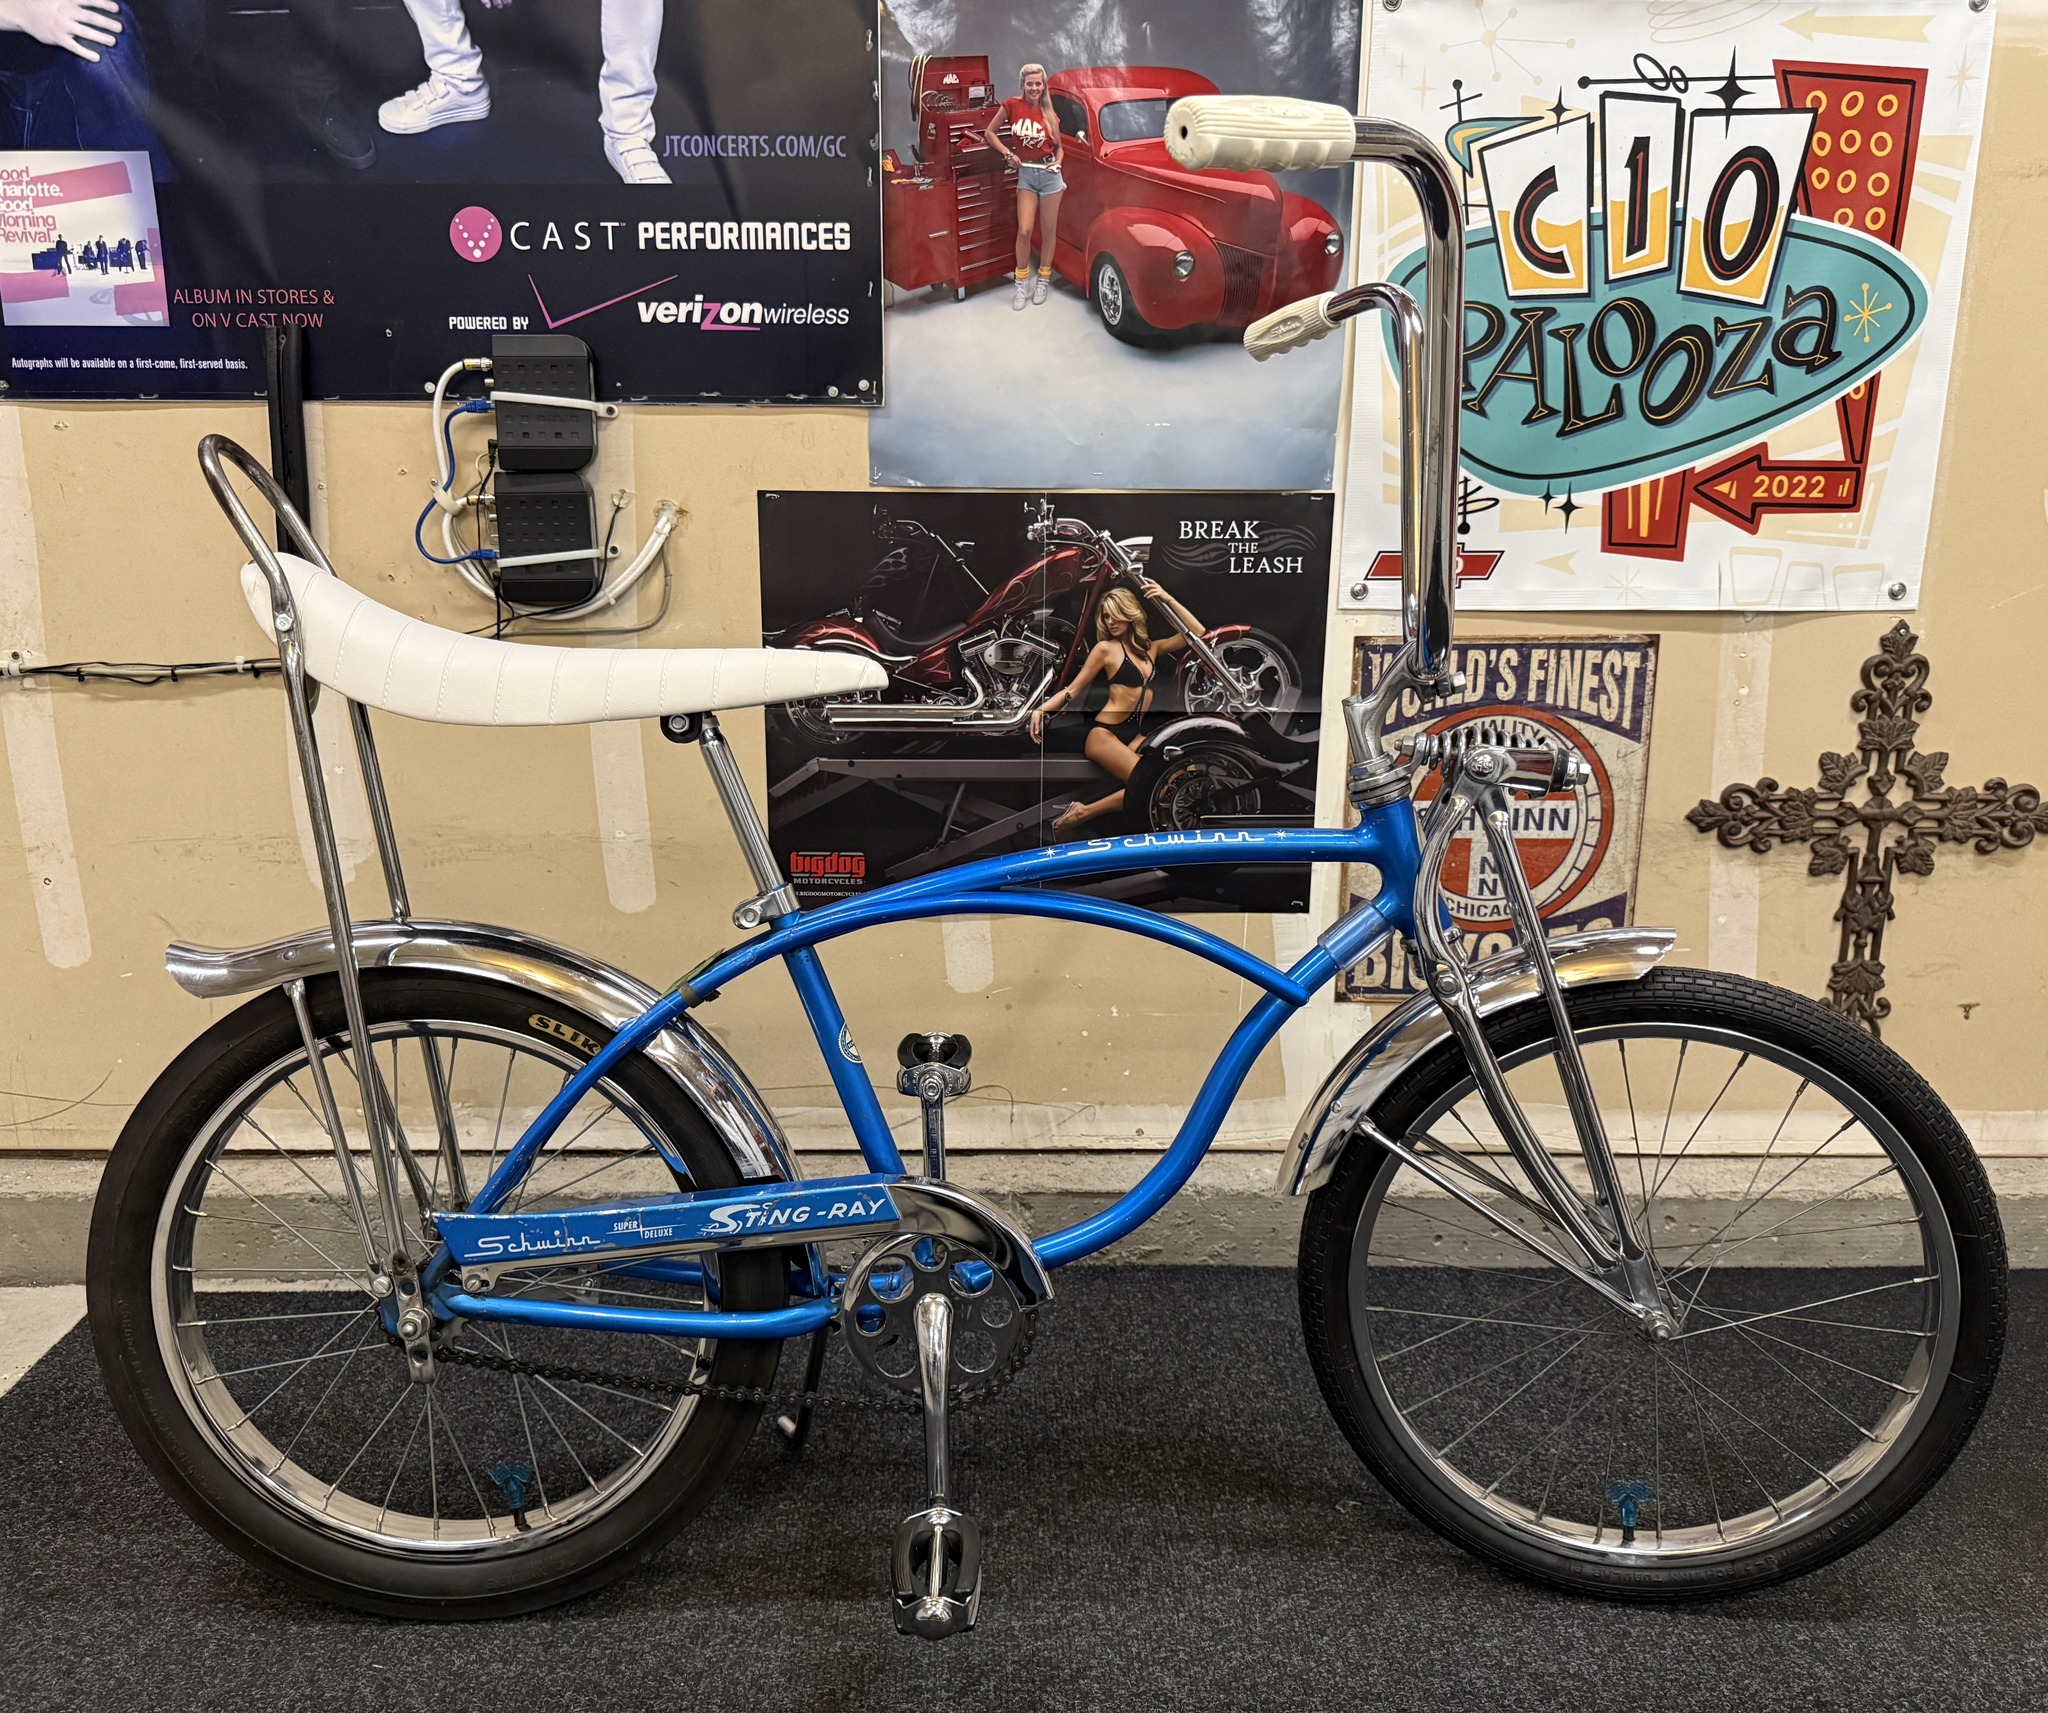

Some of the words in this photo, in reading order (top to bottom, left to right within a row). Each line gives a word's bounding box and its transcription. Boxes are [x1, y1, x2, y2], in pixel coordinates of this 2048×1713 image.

[1012, 118, 1046, 137] MAC
[663, 135, 847, 158] JTCONCERTS.COM/GC
[0, 165, 30, 181] ood
[0, 181, 64, 197] harlotte.
[0, 196, 33, 211] ood
[1513, 136, 1780, 281] C10
[510, 221, 620, 251] CAST
[638, 221, 851, 251] PERFORMANCES
[173, 289, 232, 304] ALBUM
[236, 289, 252, 304] IN
[257, 289, 319, 305] STORES
[323, 289, 335, 304] &
[192, 313, 217, 328] ON
[220, 313, 231, 328] V
[236, 313, 278, 328] CAST
[282, 313, 324, 328] NOW
[449, 316, 508, 330] POWERED
[513, 316, 529, 330] BY
[11, 357, 53, 370] Autographs
[54, 358, 69, 368] will
[70, 358, 80, 368] be
[82, 358, 116, 369] available
[117, 359, 128, 369] on
[129, 360, 135, 369] a
[136, 358, 178, 370] first-come,
[179, 358, 223, 369] first-served
[225, 358, 248, 369] basis.
[1752, 475, 1826, 498] 2022
[1178, 520, 1260, 539] BREAK
[1227, 542, 1259, 554] THE
[1229, 557, 1304, 573] LEASH
[1369, 649, 1518, 726] LD'S
[1527, 648, 1642, 730] FINEST
[1416, 808, 1571, 831] HINN
[1067, 829, 1265, 856] Schwinn
[793, 877, 863, 885] MOTORCYCLES
[1445, 897, 1512, 918] CHICA
[535, 1016, 599, 1055] SLIK
[613, 1220, 638, 1232] SUPER
[644, 1227, 673, 1239] DELUXE
[463, 1229, 601, 1258] Schwinn
